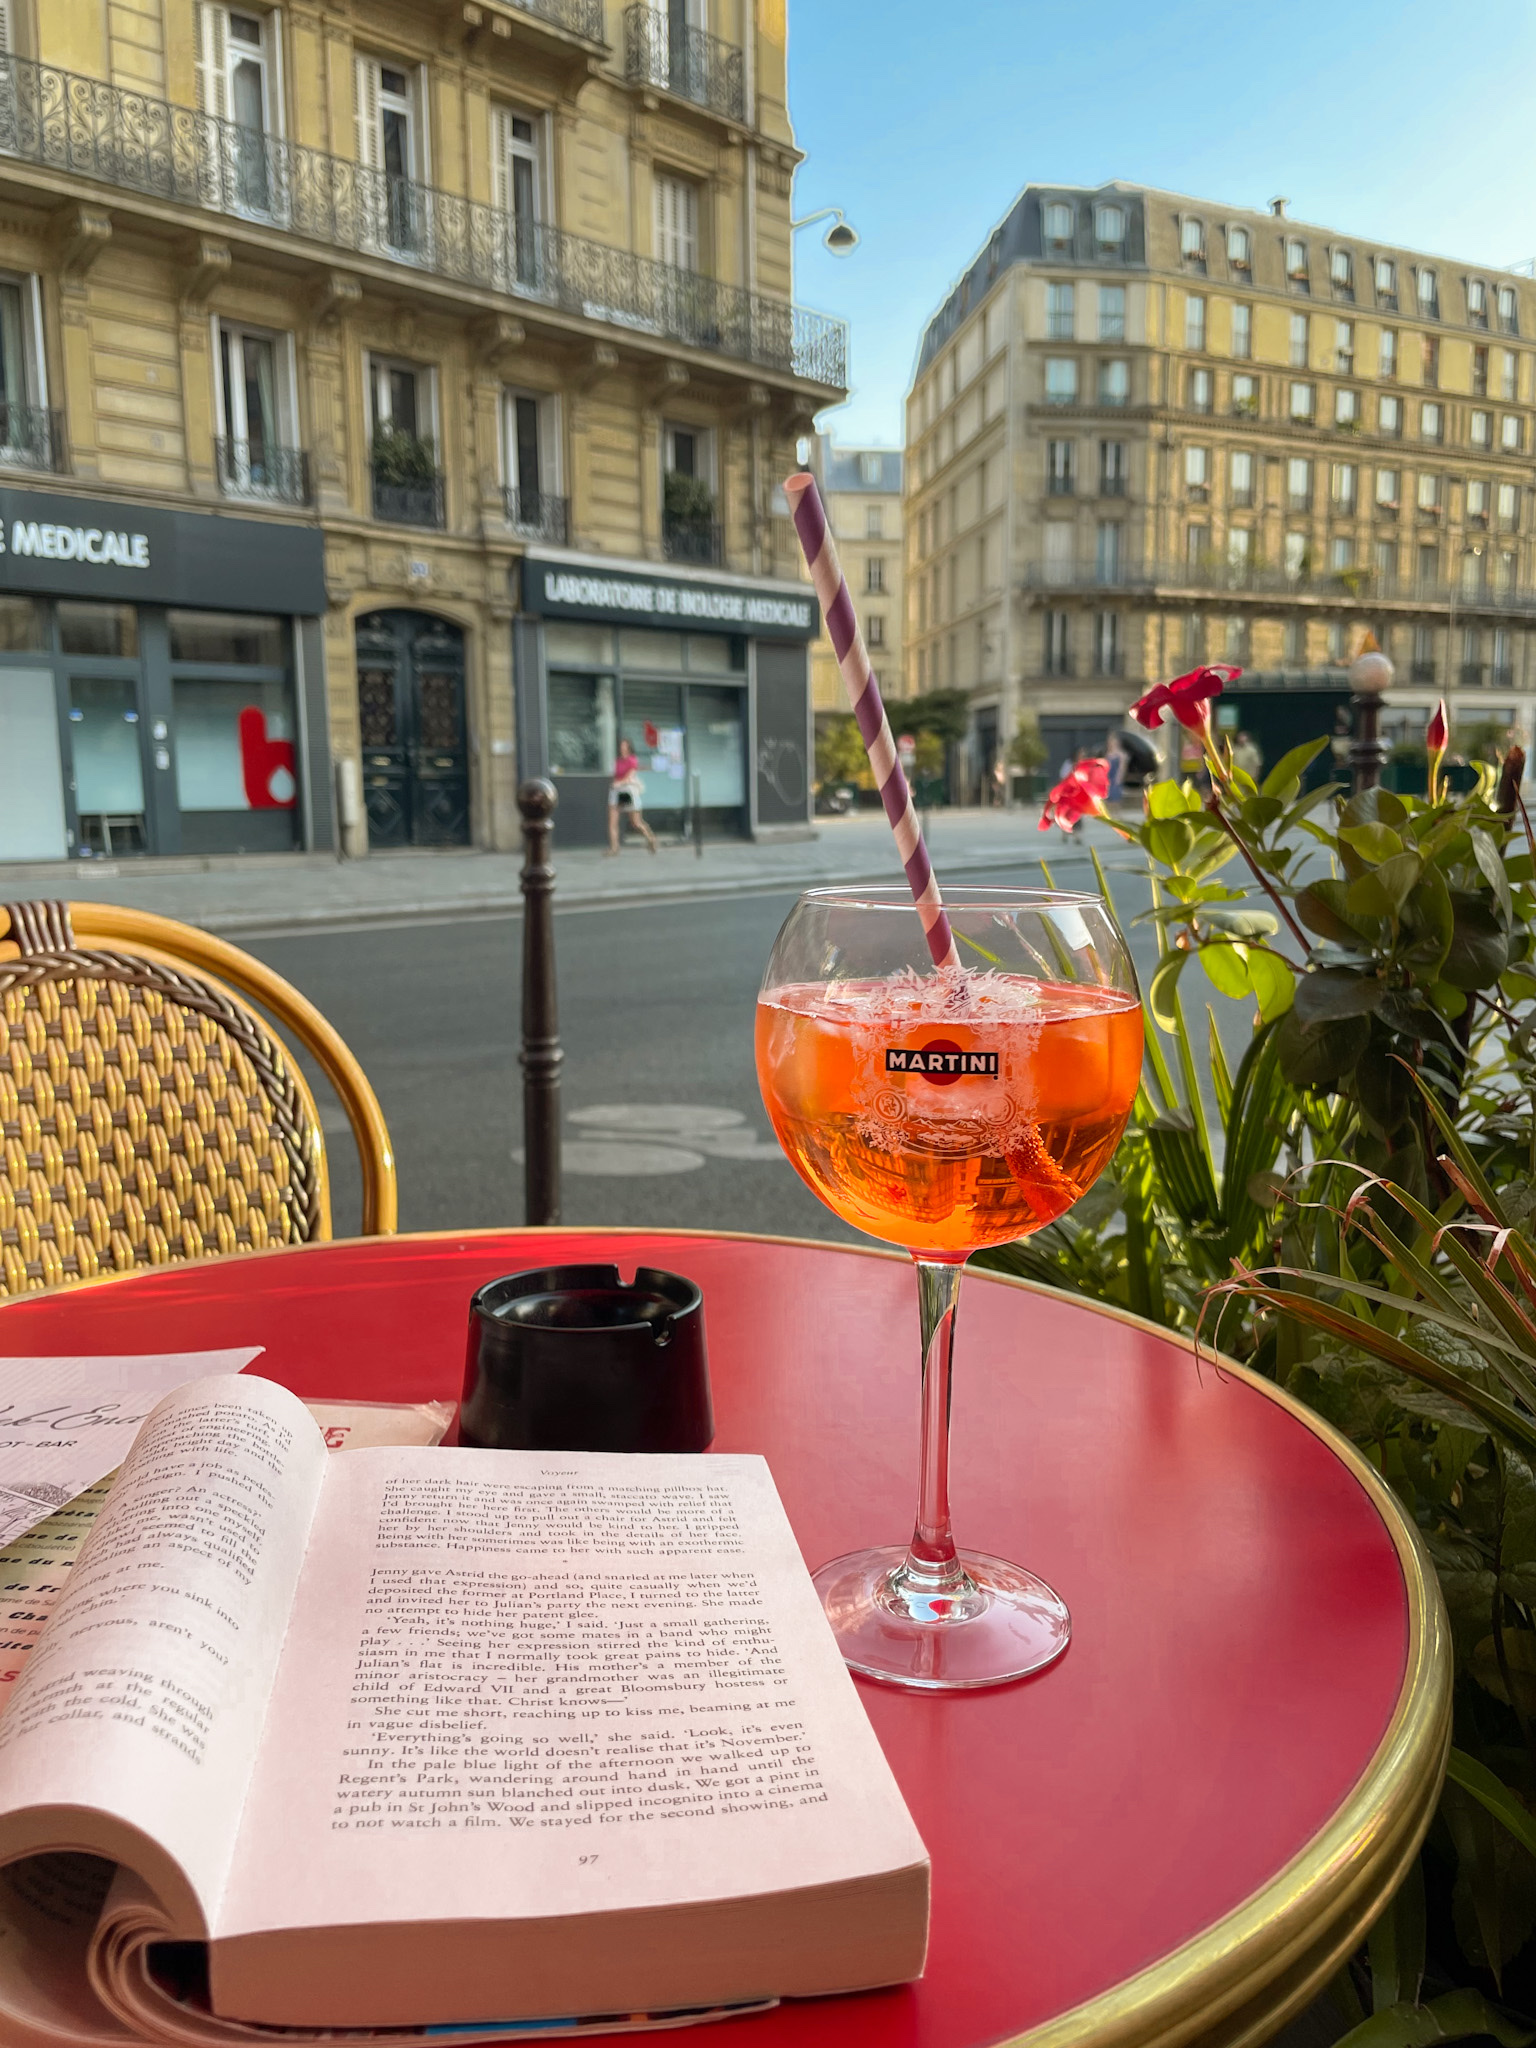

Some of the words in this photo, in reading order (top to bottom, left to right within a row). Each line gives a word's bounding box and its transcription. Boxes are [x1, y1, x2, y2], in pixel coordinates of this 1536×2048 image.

[11, 519, 151, 568] MEDICALE
[544, 572, 652, 610] LABORATOIRE
[656, 586, 676, 614] DE
[746, 597, 812, 628] MEDICALE
[889, 1052, 996, 1072] MARTINI
[208, 1471, 252, 1493] pushed
[258, 1493, 274, 1510] the
[142, 1522, 194, 1532] seemed
[201, 1527, 215, 1538] to
[220, 1534, 237, 1548] fill
[241, 1547, 257, 1566] the
[446, 1542, 511, 1552] Happiness
[658, 1547, 712, 1556] apparent
[116, 1564, 131, 1574] at
[168, 1542, 212, 1559] aspect
[218, 1556, 234, 1567] of
[234, 1568, 252, 1586] my
[372, 1568, 408, 1576] Jenny
[446, 1569, 484, 1577] Astrid
[511, 1573, 570, 1582] go-ahead
[573, 1573, 601, 1582] (and
[99, 1583, 147, 1598] where
[152, 1584, 180, 1595] you
[184, 1590, 213, 1610] sink
[216, 1606, 240, 1631] into
[387, 1606, 440, 1615] attempt
[463, 1608, 492, 1616] hide
[522, 1611, 564, 1620] patent
[568, 1611, 598, 1620] glee.
[70, 1617, 138, 1639] nervous,
[148, 1618, 193, 1640] aren’t
[200, 1640, 229, 1667] you?
[83, 1668, 154, 1684] weaving
[160, 1678, 213, 1721] through
[352, 1682, 389, 1691] child
[399, 1682, 413, 1690] of
[424, 1684, 484, 1693] Edward
[491, 1683, 513, 1693] VII
[523, 1686, 550, 1694] and
[576, 1684, 612, 1696] great
[621, 1682, 706, 1692] Bloomsbury
[715, 1678, 765, 1688] hostess
[64, 1696, 94, 1708] the
[150, 1703, 176, 1726] She
[182, 1723, 206, 1750] was
[95, 1680, 114, 1690] at
[126, 1682, 152, 1696] the
[162, 1696, 210, 1735] regular
[347, 1719, 361, 1729] in
[369, 1722, 413, 1732] vague
[419, 1720, 487, 1729] disbelief.
[375, 1706, 401, 1715] She
[406, 1707, 430, 1716] cut
[463, 1708, 507, 1719] short,
[513, 1709, 576, 1721] reaching
[582, 1711, 600, 1720] up
[605, 1708, 620, 1716] to
[626, 1707, 653, 1716] kiss
[689, 1702, 752, 1713] beaming
[756, 1699, 769, 1709] at
[48, 1709, 104, 1724] collar,
[112, 1712, 146, 1727] and
[151, 1724, 202, 1766] strands
[340, 1772, 407, 1786] Regent’s
[417, 1773, 459, 1786] Park,
[470, 1773, 554, 1787] wandering
[562, 1772, 619, 1784] around
[628, 1769, 667, 1780] hand
[676, 1767, 691, 1777] in
[700, 1763, 739, 1774] hand
[748, 1758, 785, 1771] until
[792, 1755, 815, 1765] the
[368, 1759, 383, 1769] In
[391, 1758, 416, 1768] the
[424, 1760, 456, 1772] pale
[463, 1759, 497, 1770] blue
[504, 1760, 538, 1773] light
[546, 1760, 562, 1770] of
[568, 1758, 592, 1768] the
[599, 1757, 674, 1768] afternoon
[709, 1748, 764, 1761] walked
[770, 1748, 790, 1758] up
[796, 1743, 811, 1753] to
[332, 1818, 350, 1830] to
[355, 1816, 384, 1828] not
[391, 1817, 441, 1829] watch
[448, 1820, 457, 1828] a
[464, 1815, 501, 1828] film.
[509, 1815, 535, 1827] We
[540, 1813, 592, 1829] stayed
[600, 1812, 623, 1823] for
[629, 1809, 654, 1821] the
[660, 1804, 715, 1820] second
[721, 1798, 794, 1814] showing,
[799, 1792, 828, 1805] and
[578, 1855, 599, 1866] 97
